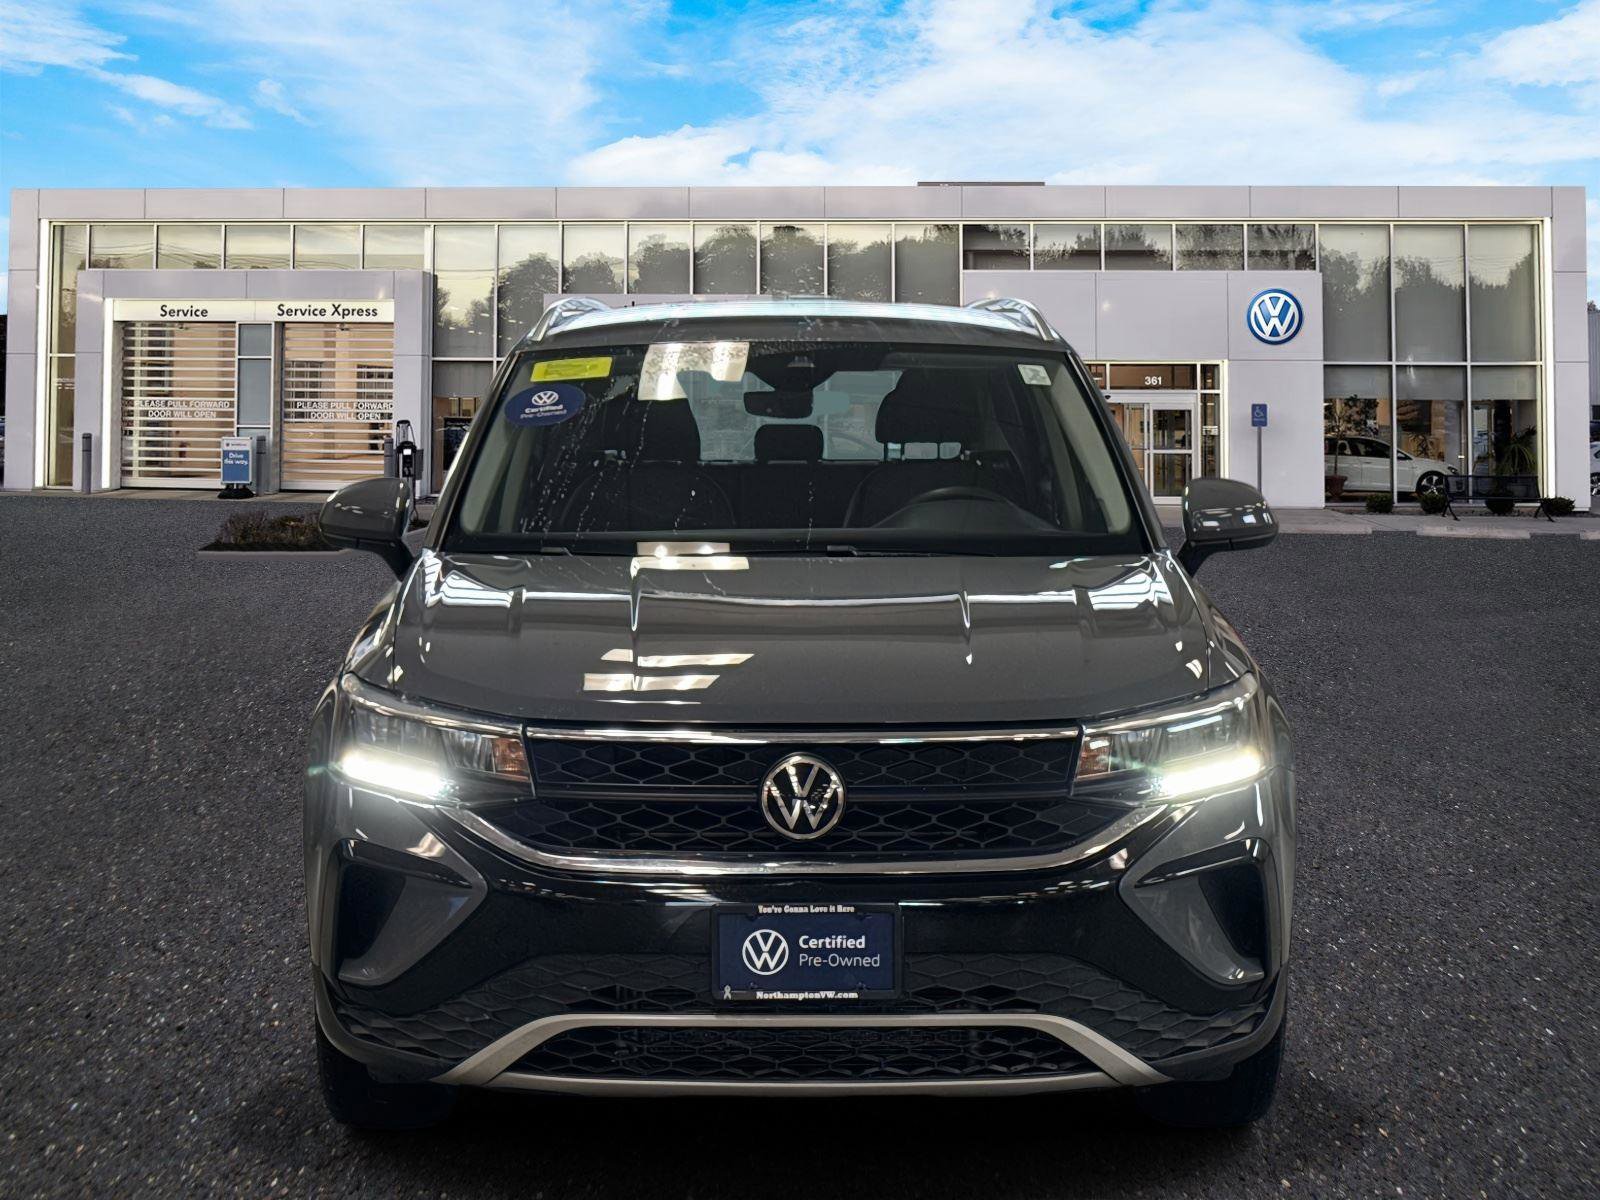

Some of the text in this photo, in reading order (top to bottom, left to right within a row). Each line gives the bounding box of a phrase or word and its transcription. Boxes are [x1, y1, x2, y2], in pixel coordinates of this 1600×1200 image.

[160, 305, 208, 317] Service
[277, 304, 378, 321] Service Xpress
[1144, 376, 1162, 385] 361
[135, 400, 230, 408] PLEASE PULL FORWARD
[297, 401, 394, 410] PLEASE PULL FORWARD
[525, 404, 563, 413] Certified
[148, 410, 172, 418] DOOR
[173, 410, 192, 418] WILL
[310, 412, 381, 420] DOOR WILL OPEN
[520, 409, 567, 419] Pre-Owned
[758, 905, 782, 913] You're
[784, 905, 809, 913] Gonna
[810, 905, 828, 913] Love
[799, 936, 865, 948] Certified
[800, 954, 880, 967] Pre-Owned
[756, 991, 858, 1000] NorthamptonVW.com
